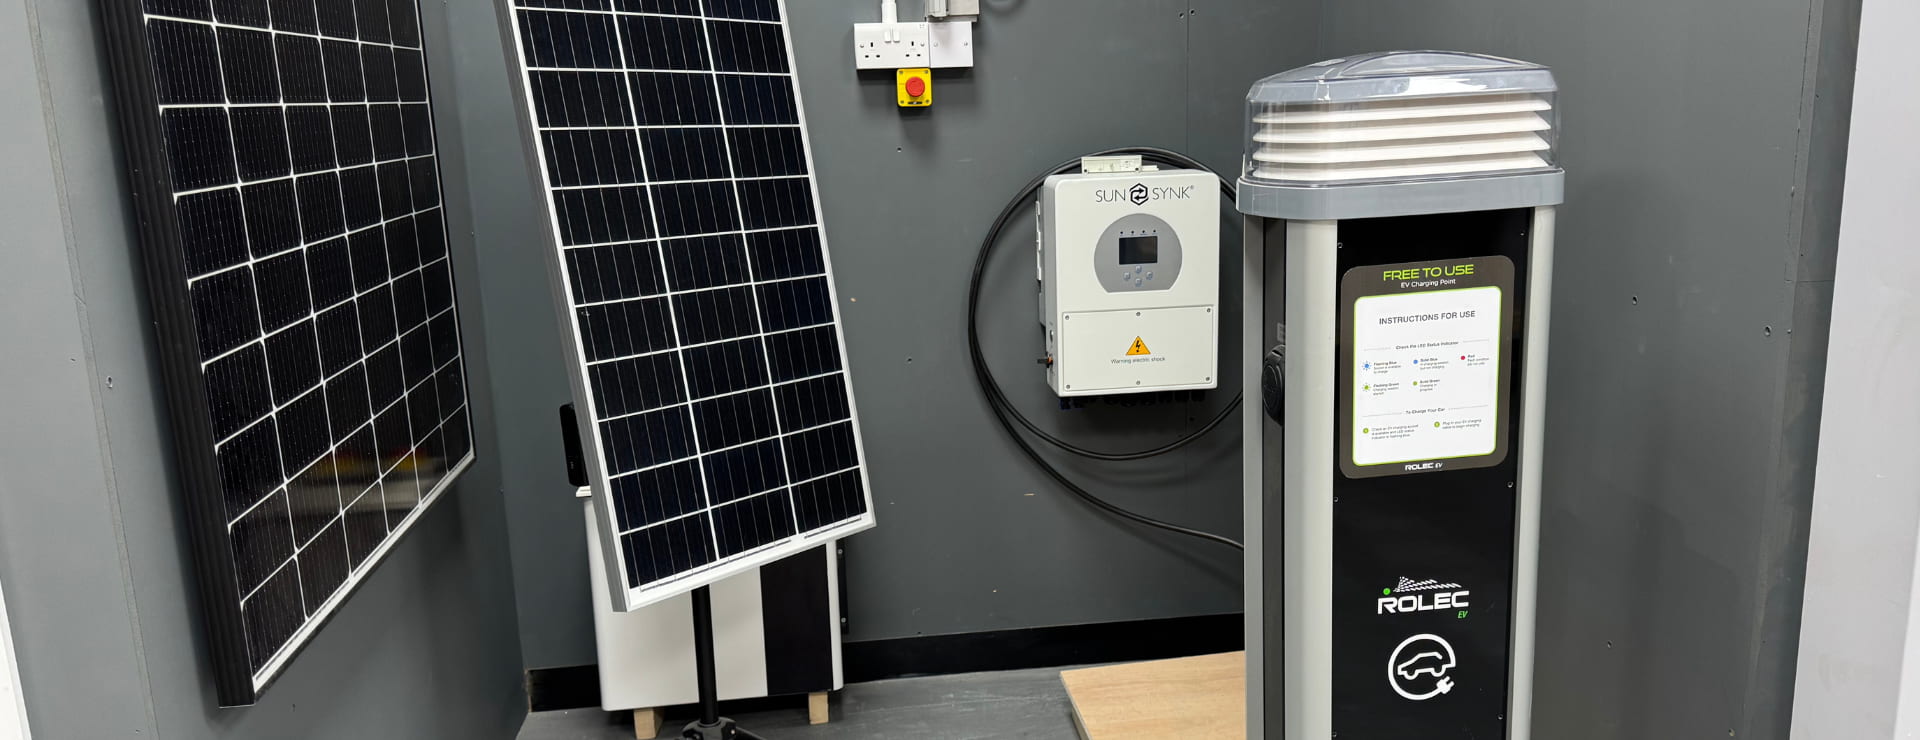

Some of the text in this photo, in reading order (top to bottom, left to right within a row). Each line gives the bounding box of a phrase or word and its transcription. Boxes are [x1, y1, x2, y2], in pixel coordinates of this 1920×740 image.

[1095, 188, 1126, 202] SUN
[1383, 264, 1475, 282] FREE TO USE
[1411, 280, 1438, 288] Charging
[1378, 310, 1476, 325] INSTRUCTIONS FOR USE
[1404, 462, 1434, 471] ROLEC
[1377, 590, 1470, 614] ROLEC
[1457, 610, 1469, 619] EV
